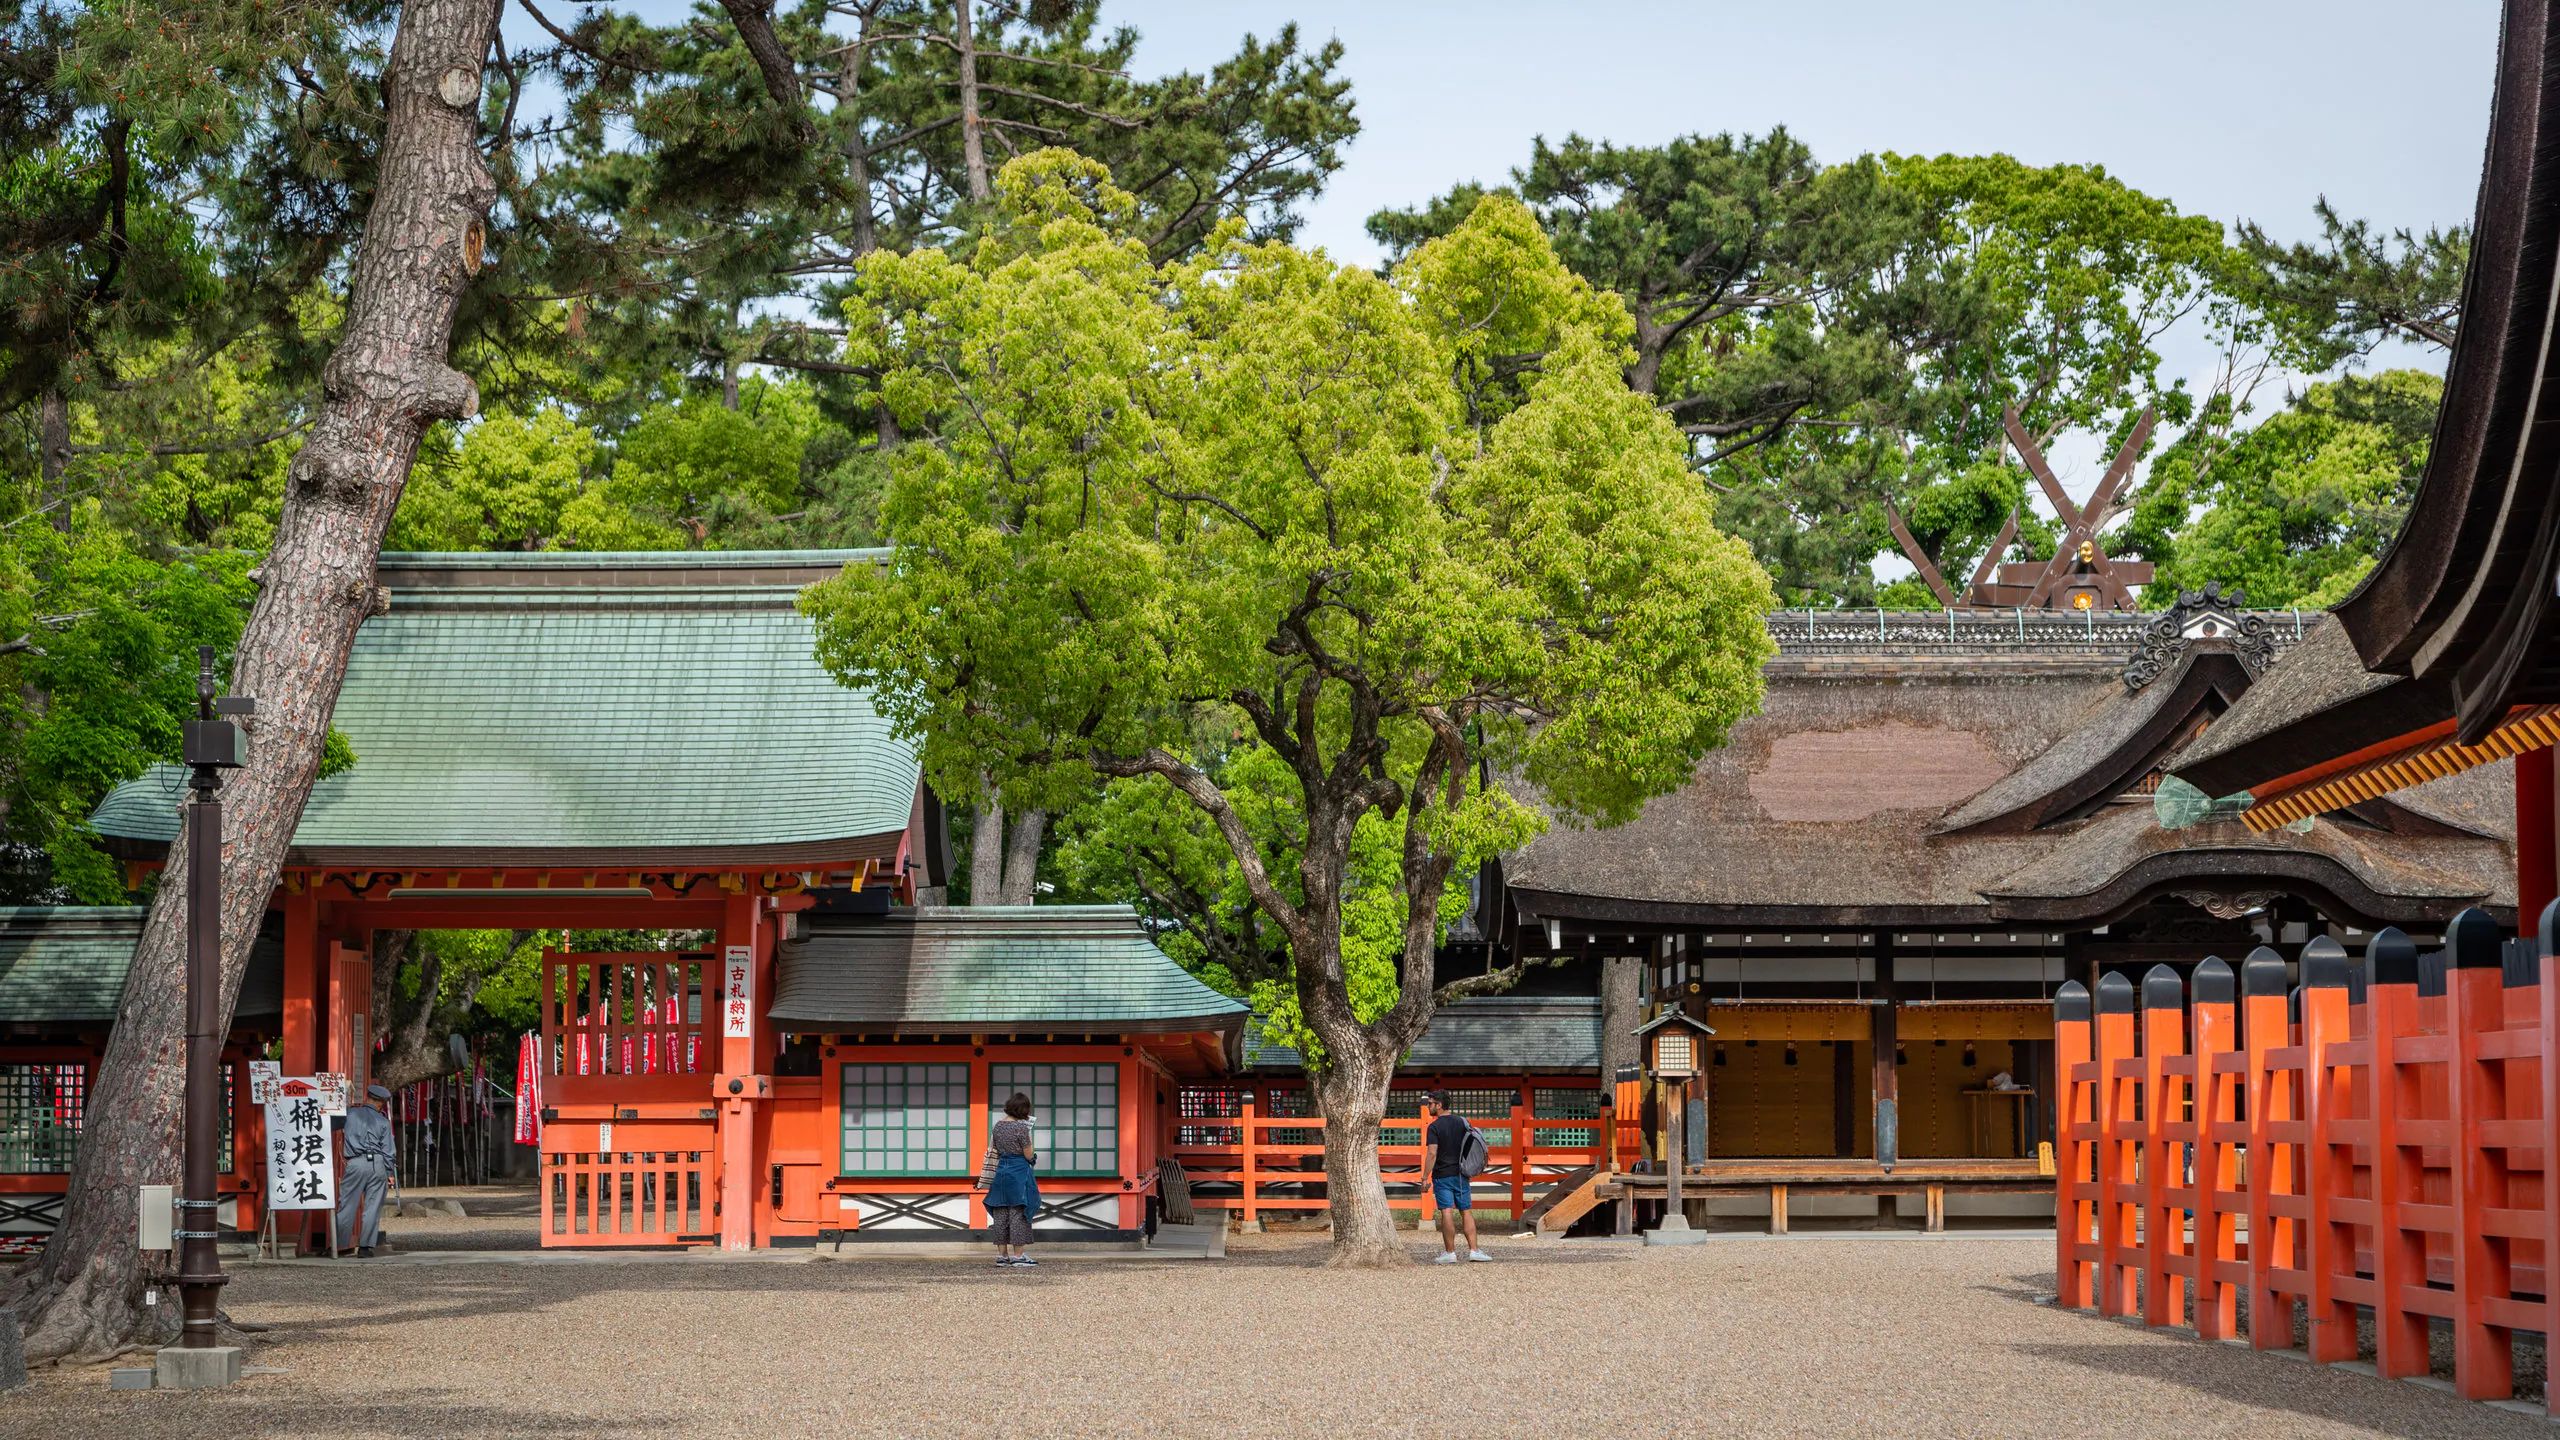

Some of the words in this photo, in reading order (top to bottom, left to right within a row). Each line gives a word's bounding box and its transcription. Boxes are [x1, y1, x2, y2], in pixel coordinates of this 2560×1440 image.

[729, 966, 746, 1032] 古札納所
[286, 1085, 306, 1095] 30m
[289, 1098, 328, 1204] 楠珺社
